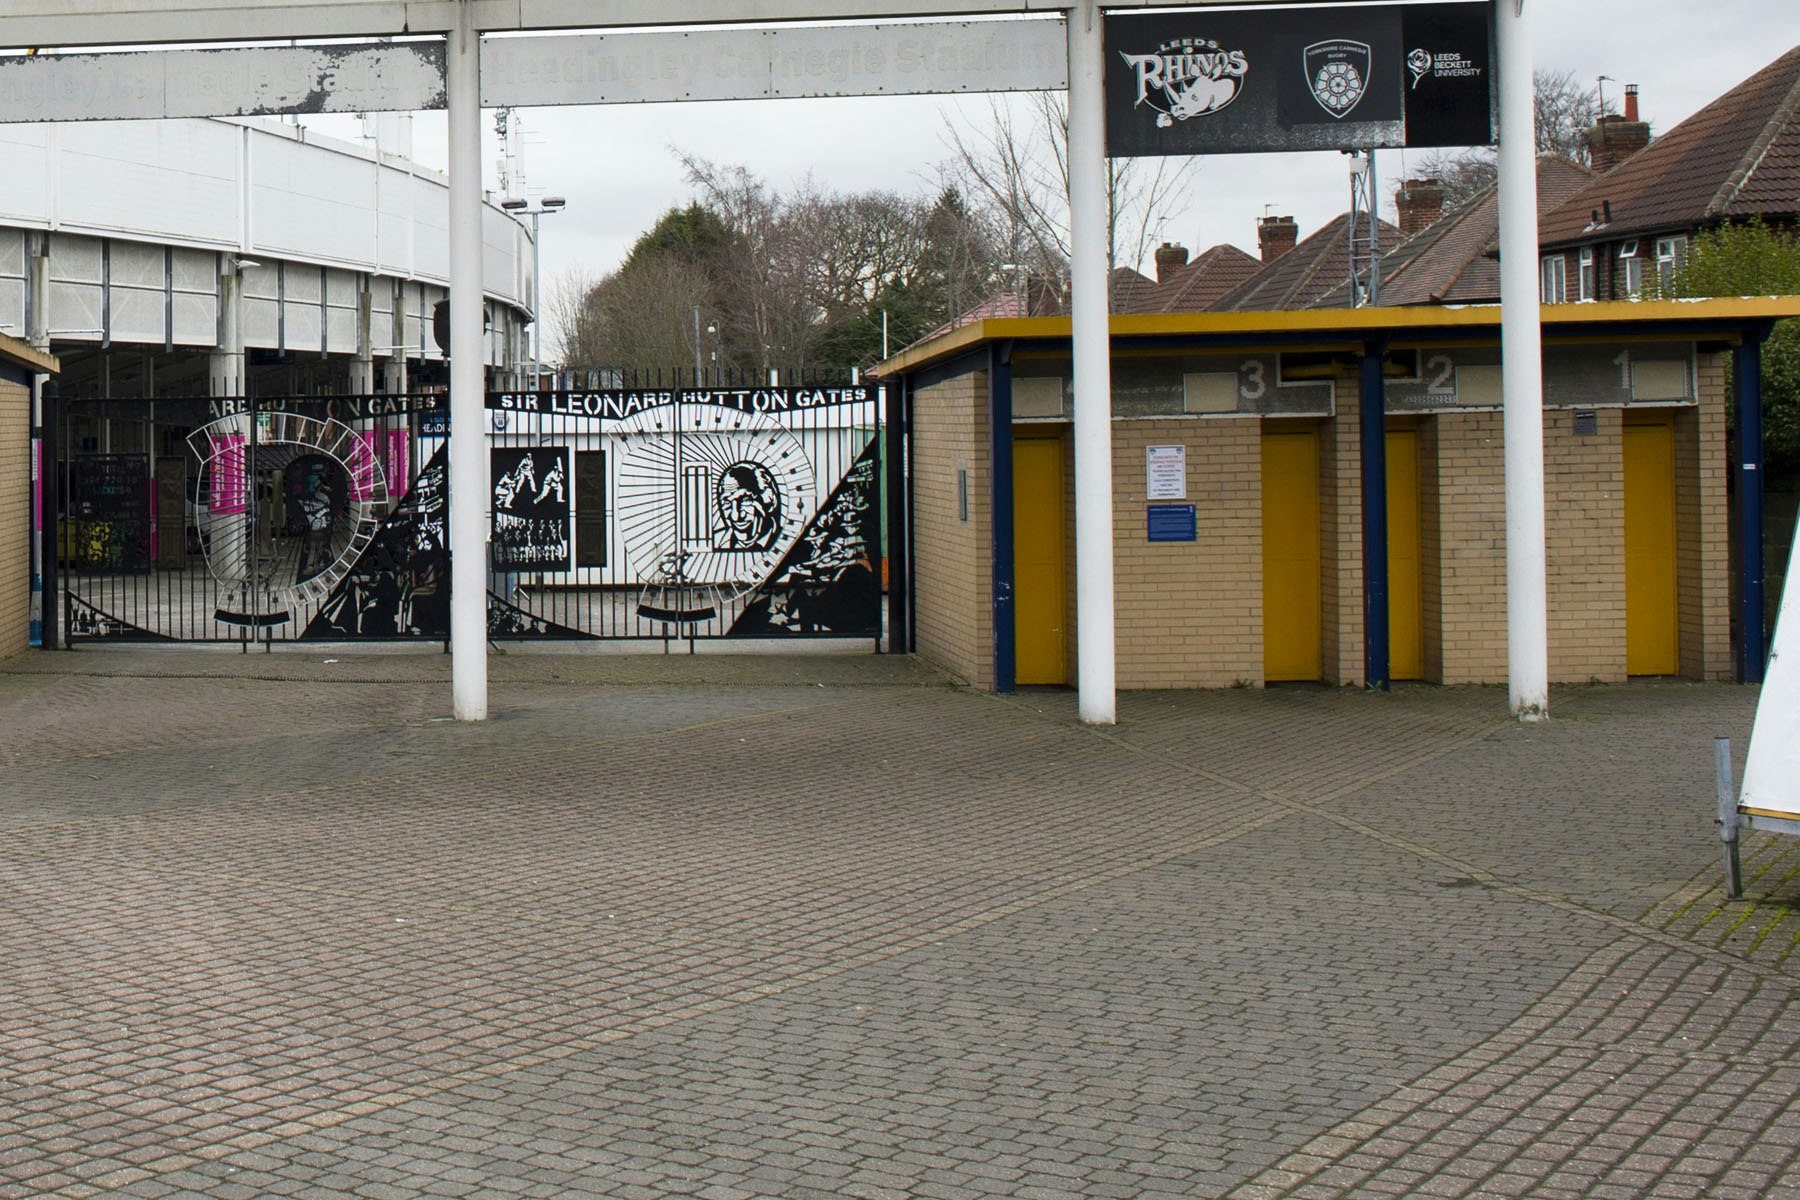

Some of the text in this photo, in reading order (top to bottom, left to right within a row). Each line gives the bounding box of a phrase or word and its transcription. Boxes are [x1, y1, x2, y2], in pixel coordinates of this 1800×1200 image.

[1160, 38, 1219, 51] LEEDS
[1434, 53, 1461, 61] LEEDS
[1434, 60, 1472, 69] BECKETT
[1434, 68, 1481, 77] UNIVERSITY
[1119, 46, 1249, 110] RHINOS
[1239, 359, 1265, 399] 3
[1426, 355, 1455, 394] 2
[1613, 349, 1629, 389] 1
[367, 395, 436, 415] GATES
[501, 388, 866, 419] SIR LEONARD HUTTON GATES
